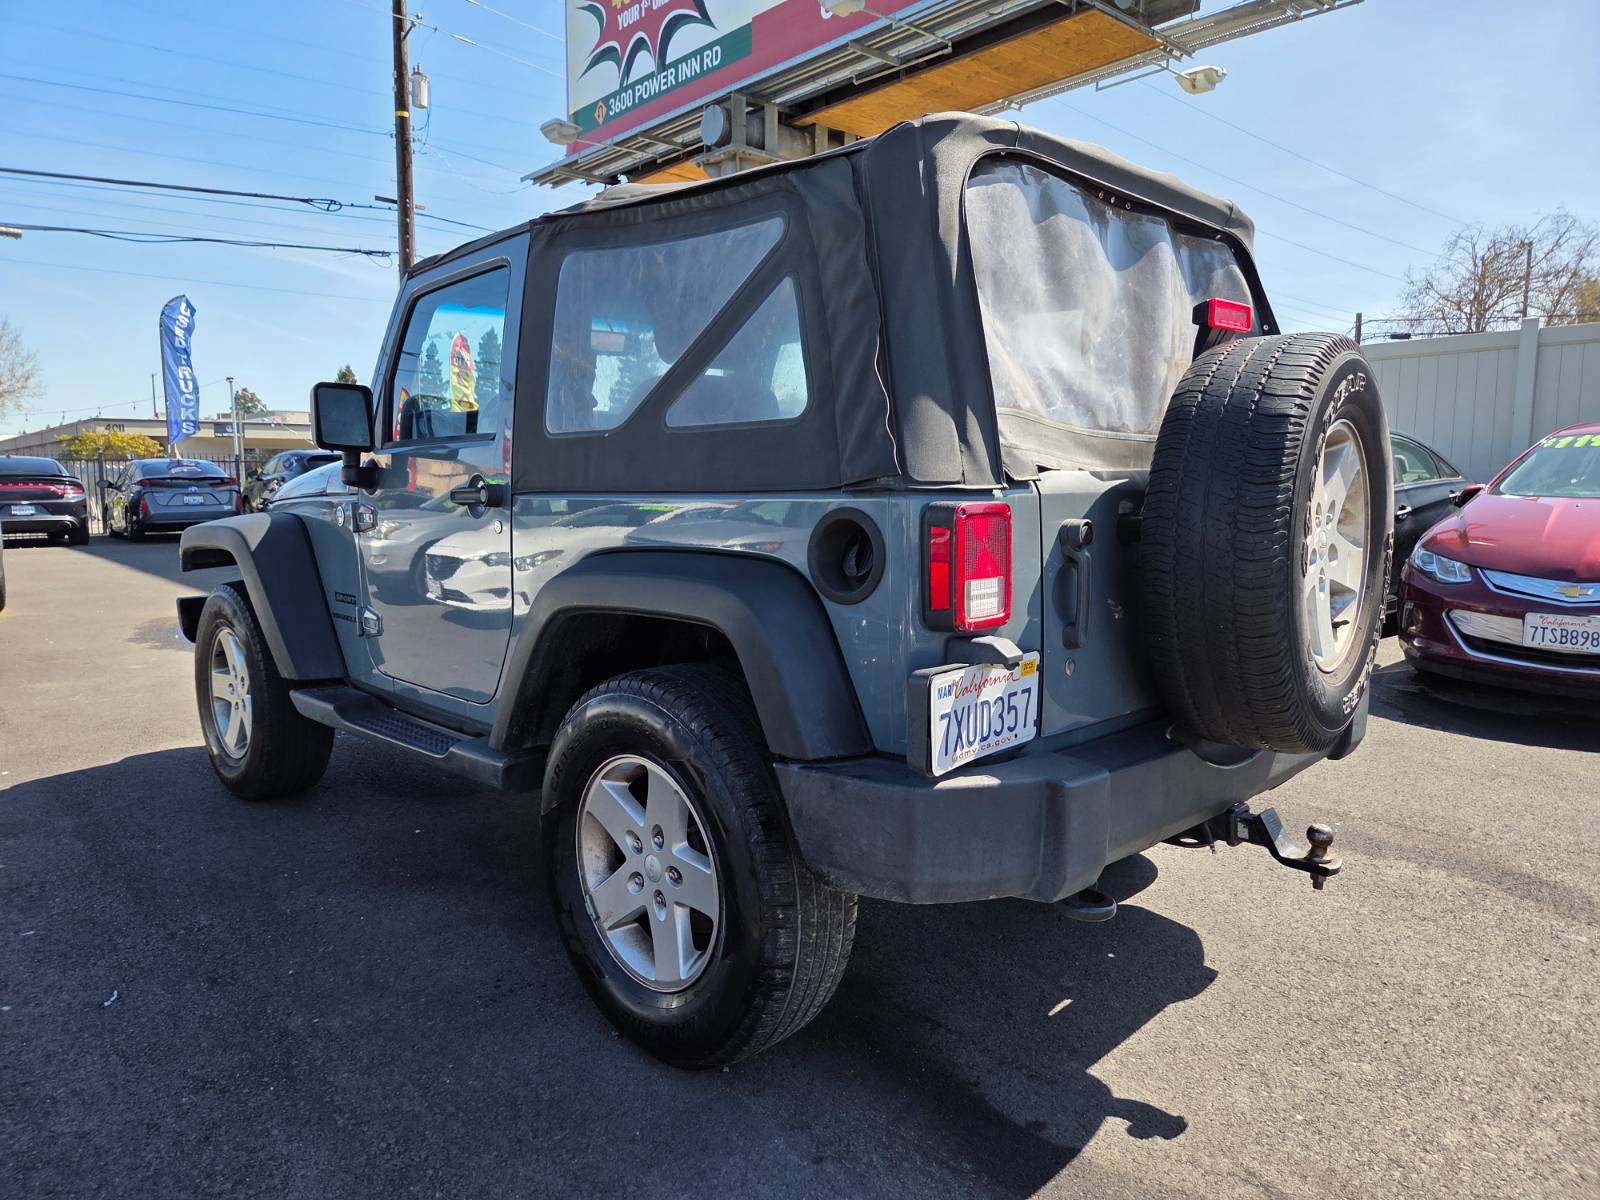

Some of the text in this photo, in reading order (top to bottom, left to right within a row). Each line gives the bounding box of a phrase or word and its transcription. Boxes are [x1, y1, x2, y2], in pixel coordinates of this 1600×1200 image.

[617, 3, 640, 31] YOUR
[608, 45, 722, 116] 3600 POWER INN RD
[1529, 625, 1600, 648] 7TSB898
[937, 684, 952, 700] MAR
[954, 671, 1020, 699] California
[940, 687, 1032, 757] 7XUD357
